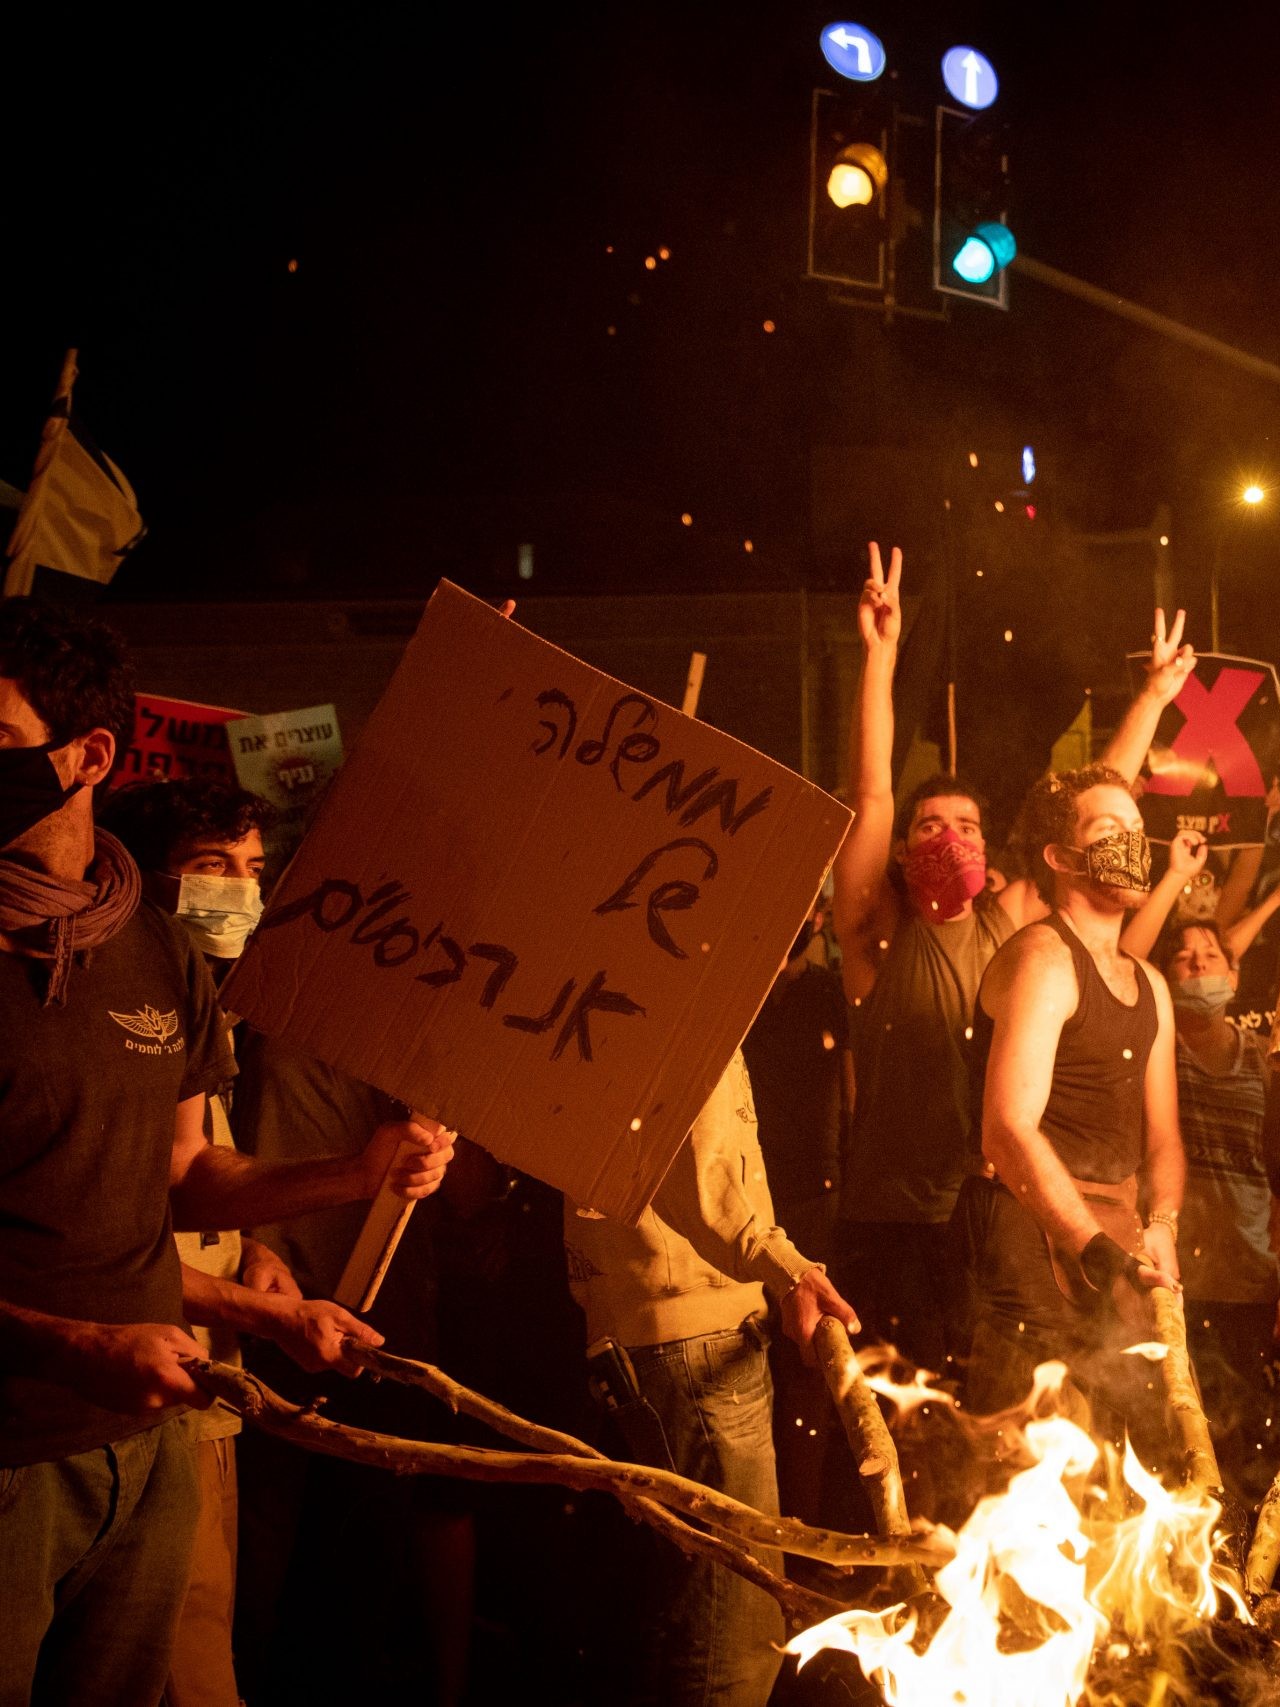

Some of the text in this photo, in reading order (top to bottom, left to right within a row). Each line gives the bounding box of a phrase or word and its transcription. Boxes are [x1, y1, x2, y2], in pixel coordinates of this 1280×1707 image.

[239, 722, 334, 753] עוצרים את
[530, 686, 774, 837] ממשלה
[592, 837, 719, 960] של
[125, 1039, 162, 1055] לוחמים
